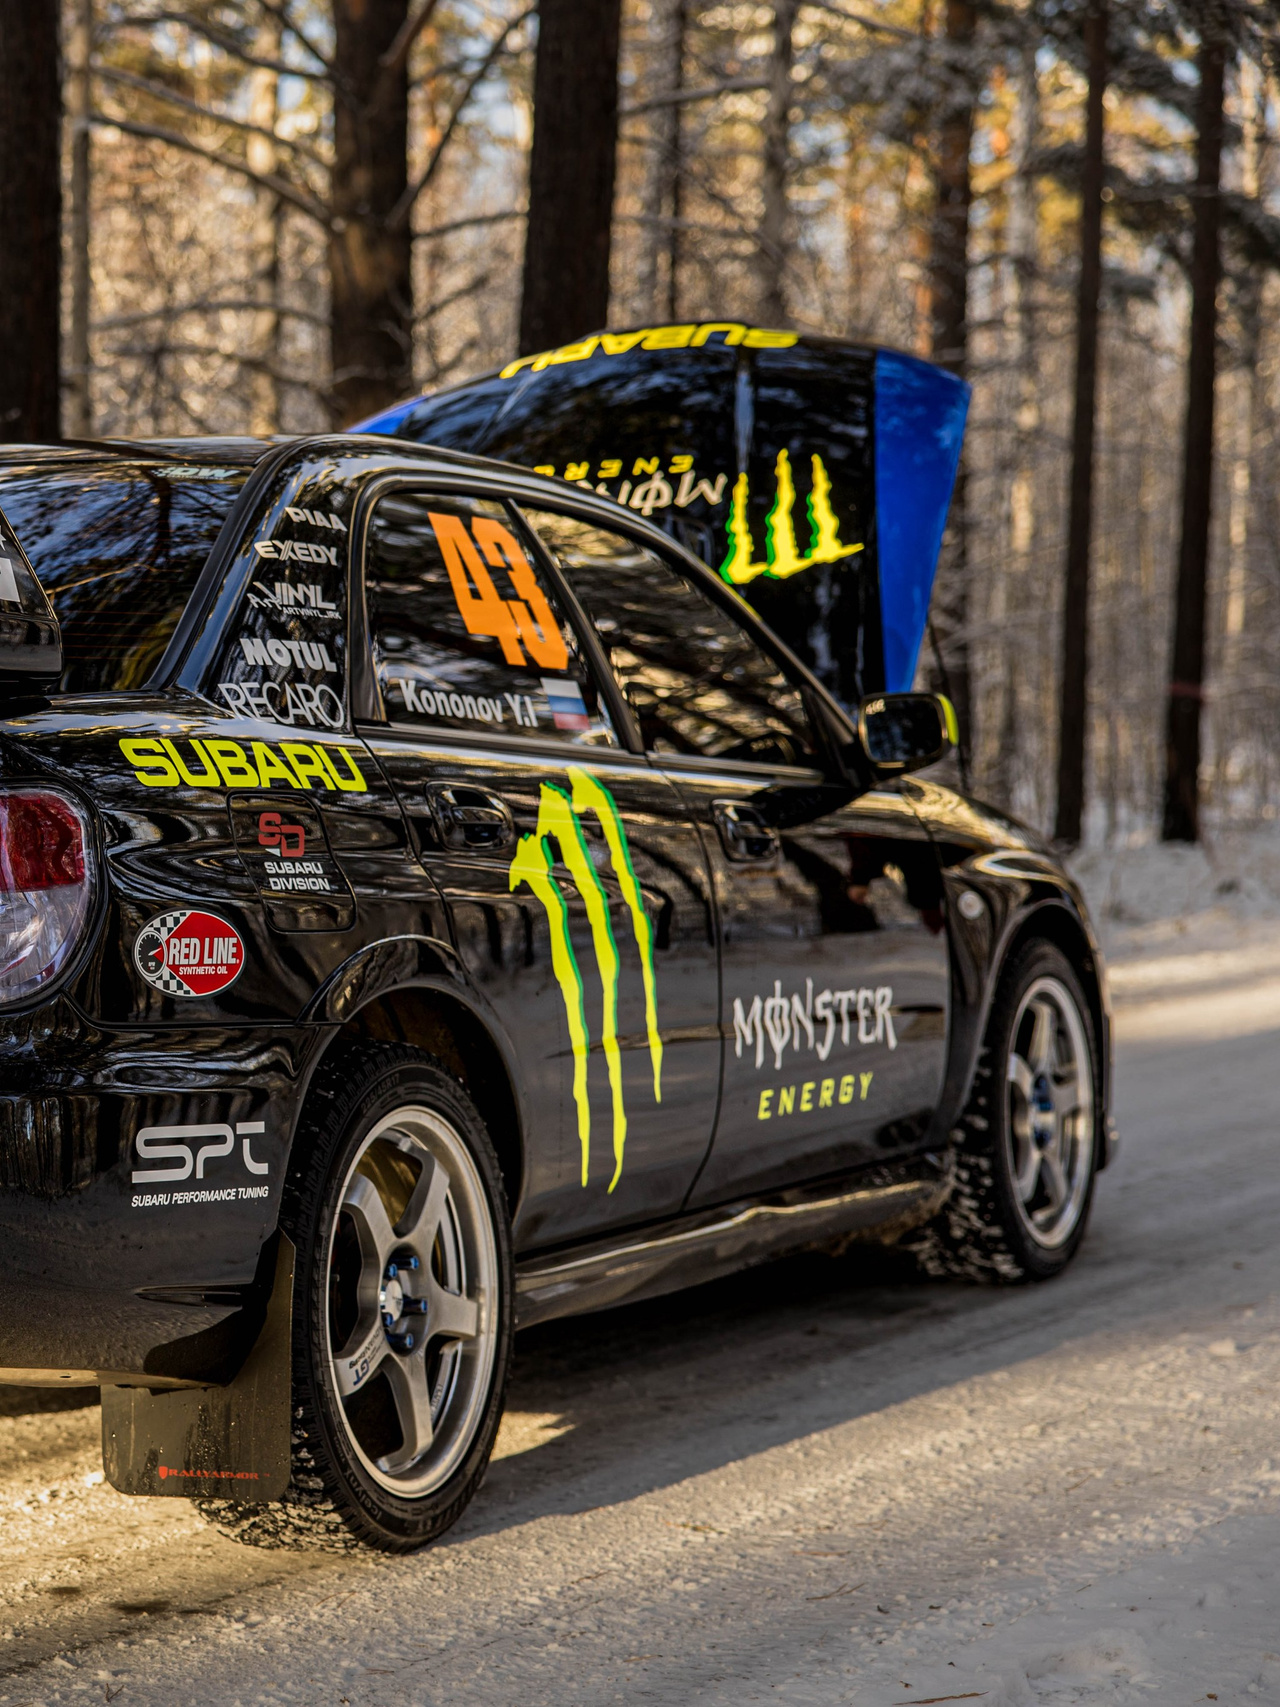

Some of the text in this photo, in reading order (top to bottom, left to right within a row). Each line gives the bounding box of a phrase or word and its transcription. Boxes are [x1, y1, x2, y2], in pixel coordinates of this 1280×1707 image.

[499, 323, 800, 379] SUBARU
[285, 507, 347, 532] PIAA
[254, 540, 338, 566] EXEDY
[428, 512, 568, 670] 43
[240, 638, 337, 672] MOTUL
[218, 682, 345, 728] RECARO
[399, 679, 503, 723] Kononov
[119, 739, 367, 792] SUBARU
[265, 862, 323, 874] SUBARU
[269, 877, 331, 891] DIVISION
[168, 937, 237, 965] RED LINE
[179, 966, 228, 975] SYNTHETIC OIL
[733, 978, 897, 1070] MONSTER
[757, 1071, 873, 1121] ENERGY
[131, 1186, 269, 1207] SUBARU PERFORMANCE TUNING
[353, 1358, 369, 1386] GT
